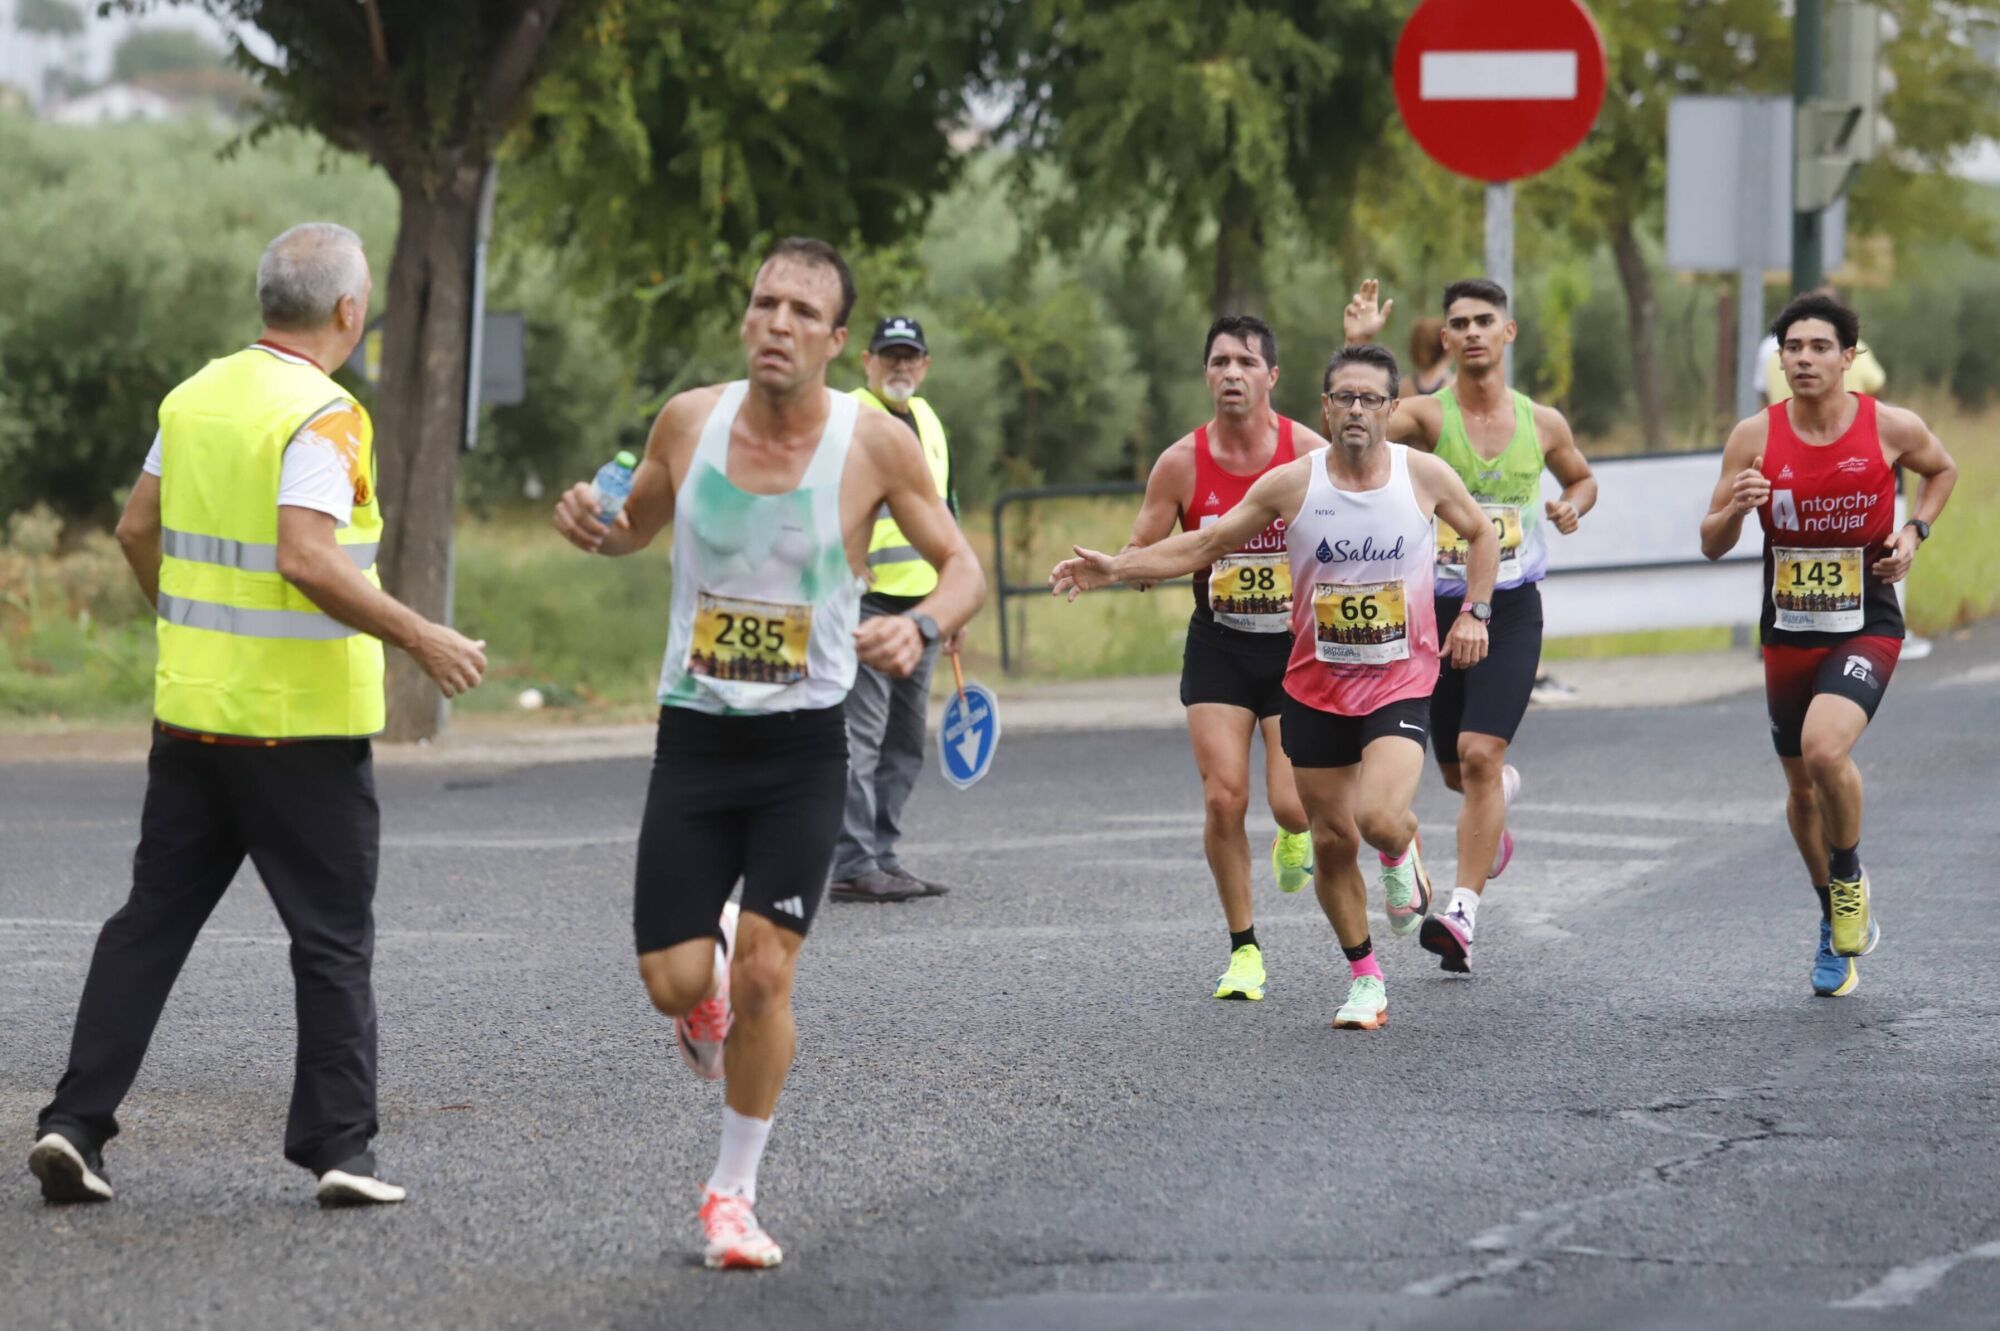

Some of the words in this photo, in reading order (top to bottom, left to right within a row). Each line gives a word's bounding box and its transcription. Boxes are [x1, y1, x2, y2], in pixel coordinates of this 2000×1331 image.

[1333, 535, 1405, 563] Salud
[1239, 567, 1275, 591] 98
[1791, 562, 1843, 586] 143
[1341, 595, 1378, 621] 66
[715, 613, 785, 653] 285
